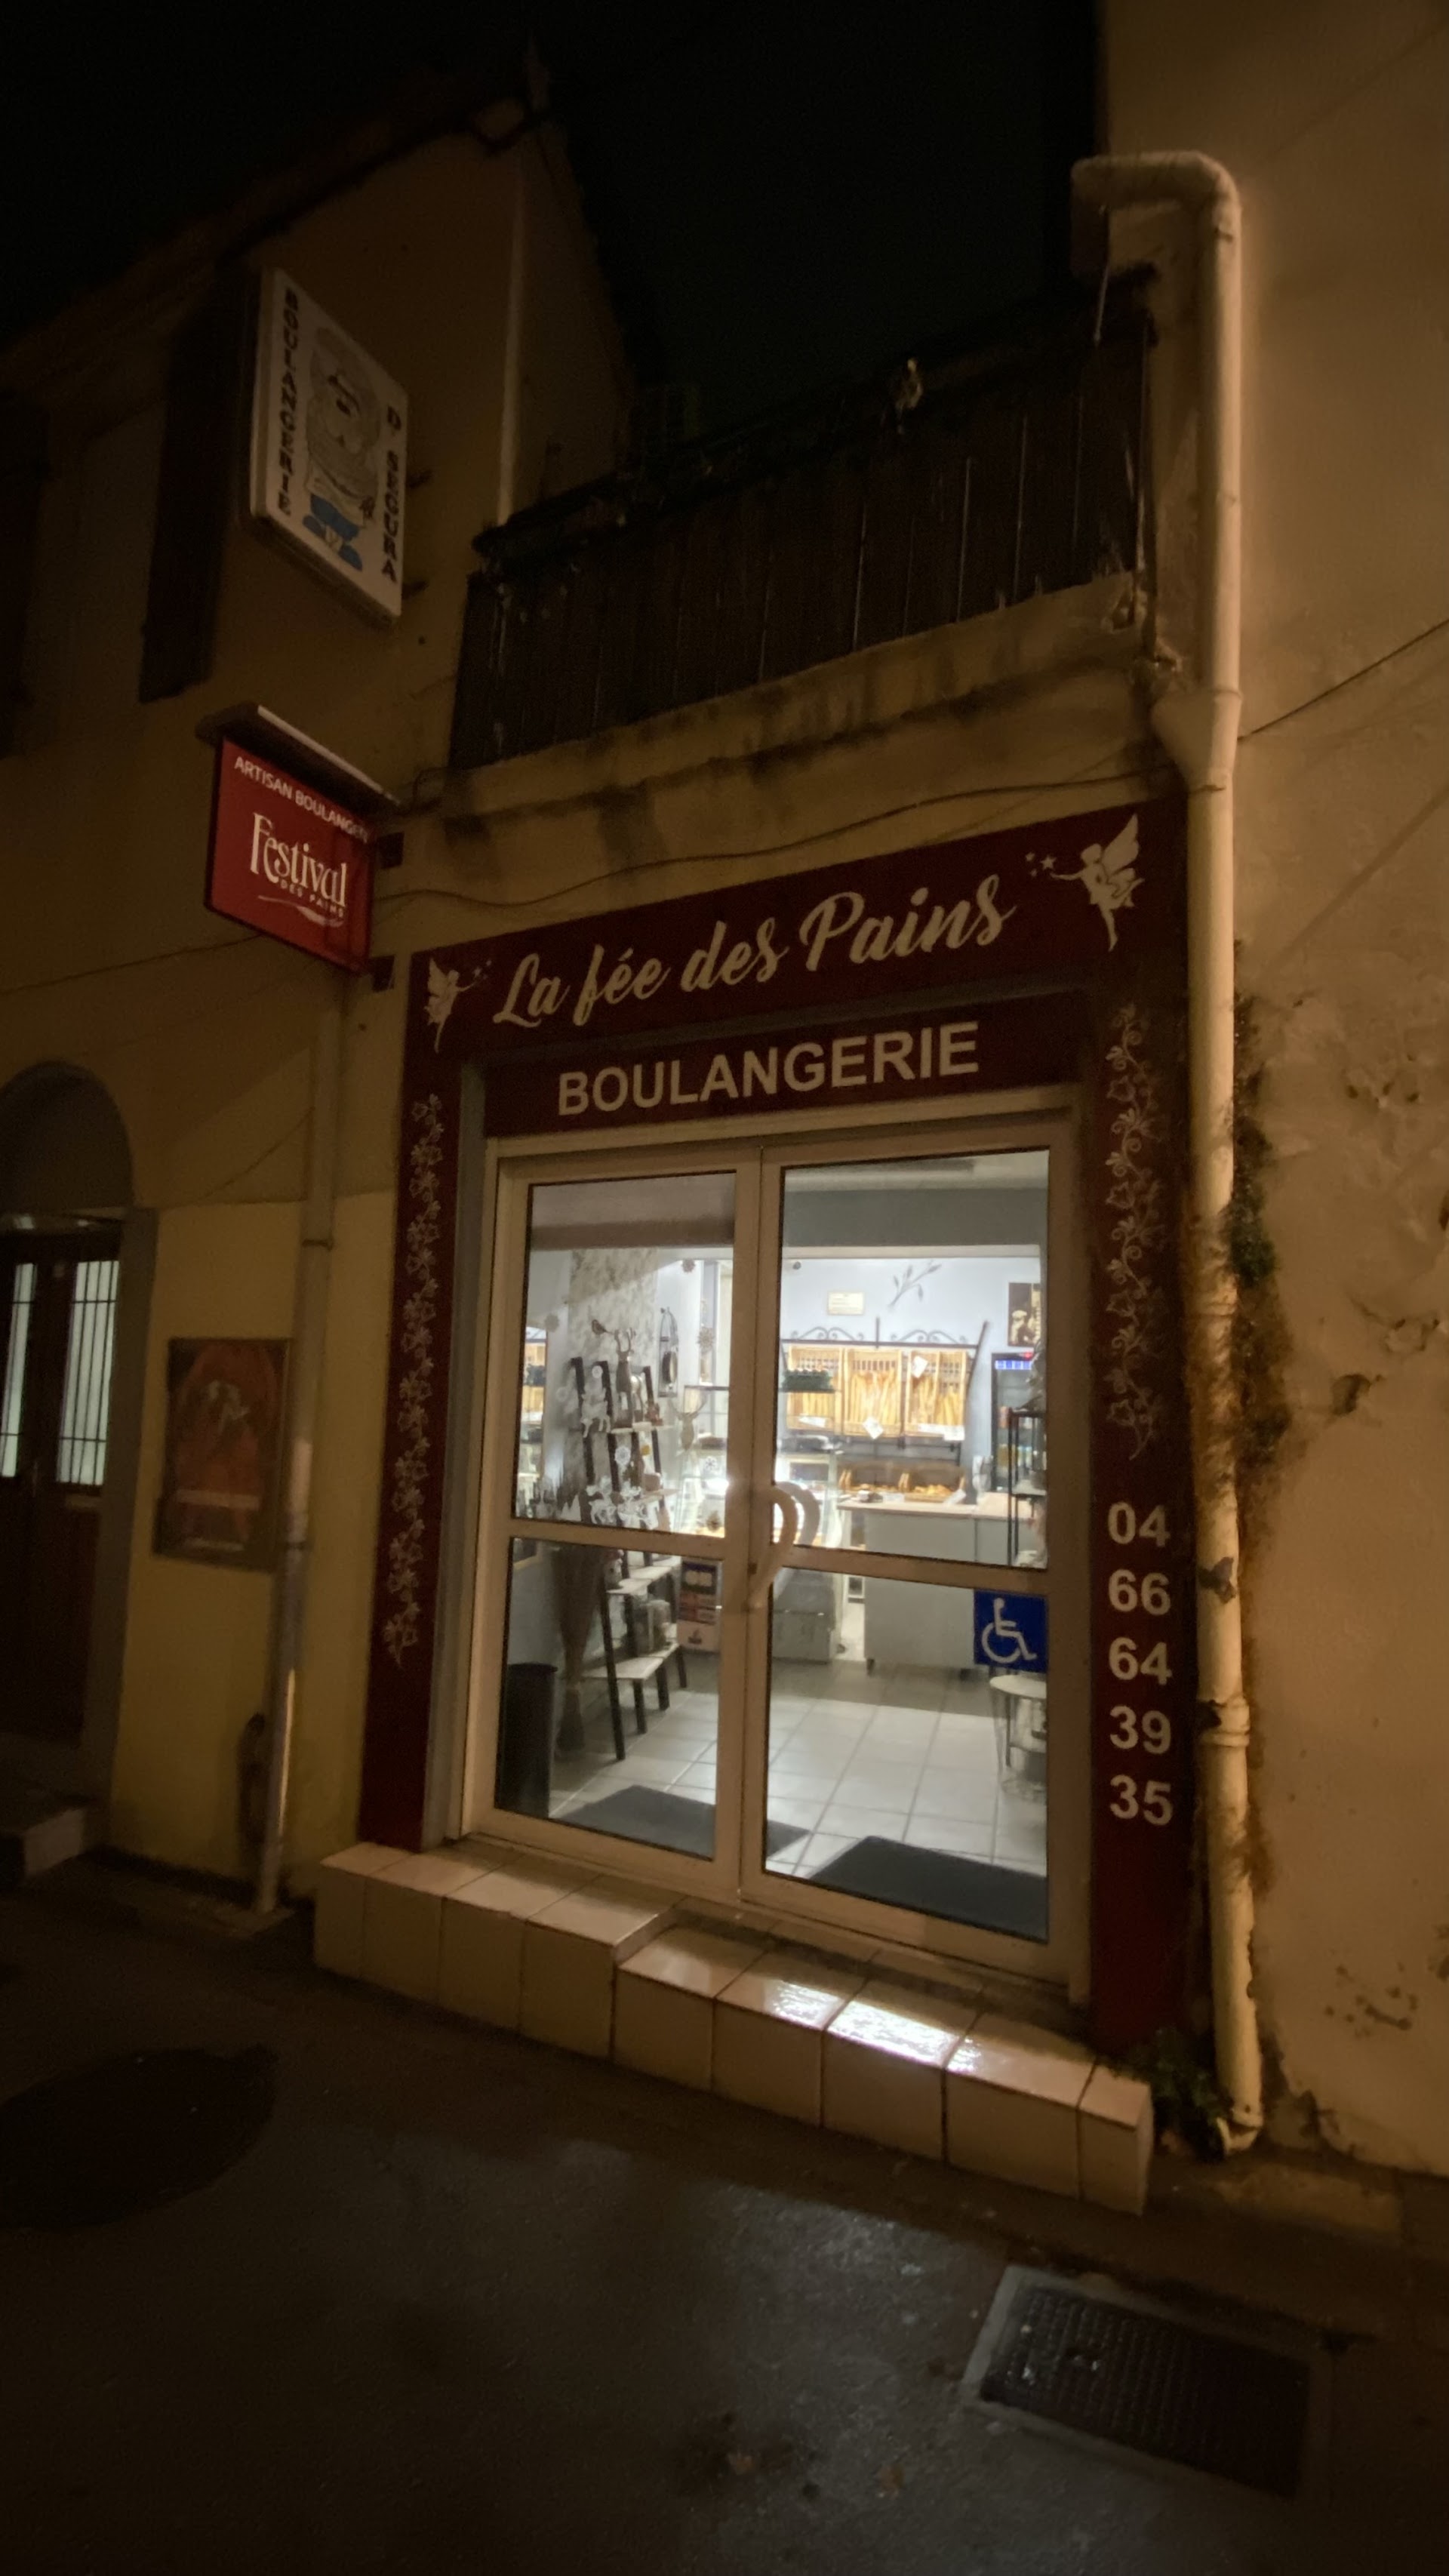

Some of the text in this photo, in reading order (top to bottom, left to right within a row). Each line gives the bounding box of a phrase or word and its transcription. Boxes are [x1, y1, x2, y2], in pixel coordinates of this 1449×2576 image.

[278, 287, 299, 516] BOULANGERIE
[234, 756, 294, 800] ARTISAN
[250, 812, 347, 907] Festival
[492, 873, 1018, 1028] La fée des Pains
[558, 1020, 980, 1116] BOULANGERIE
[1107, 1501, 1171, 1547] 04
[1108, 1568, 1172, 1616] 66
[1109, 1636, 1174, 1685] 64
[1109, 1705, 1172, 1755] 39
[1109, 1774, 1173, 1826] 35
